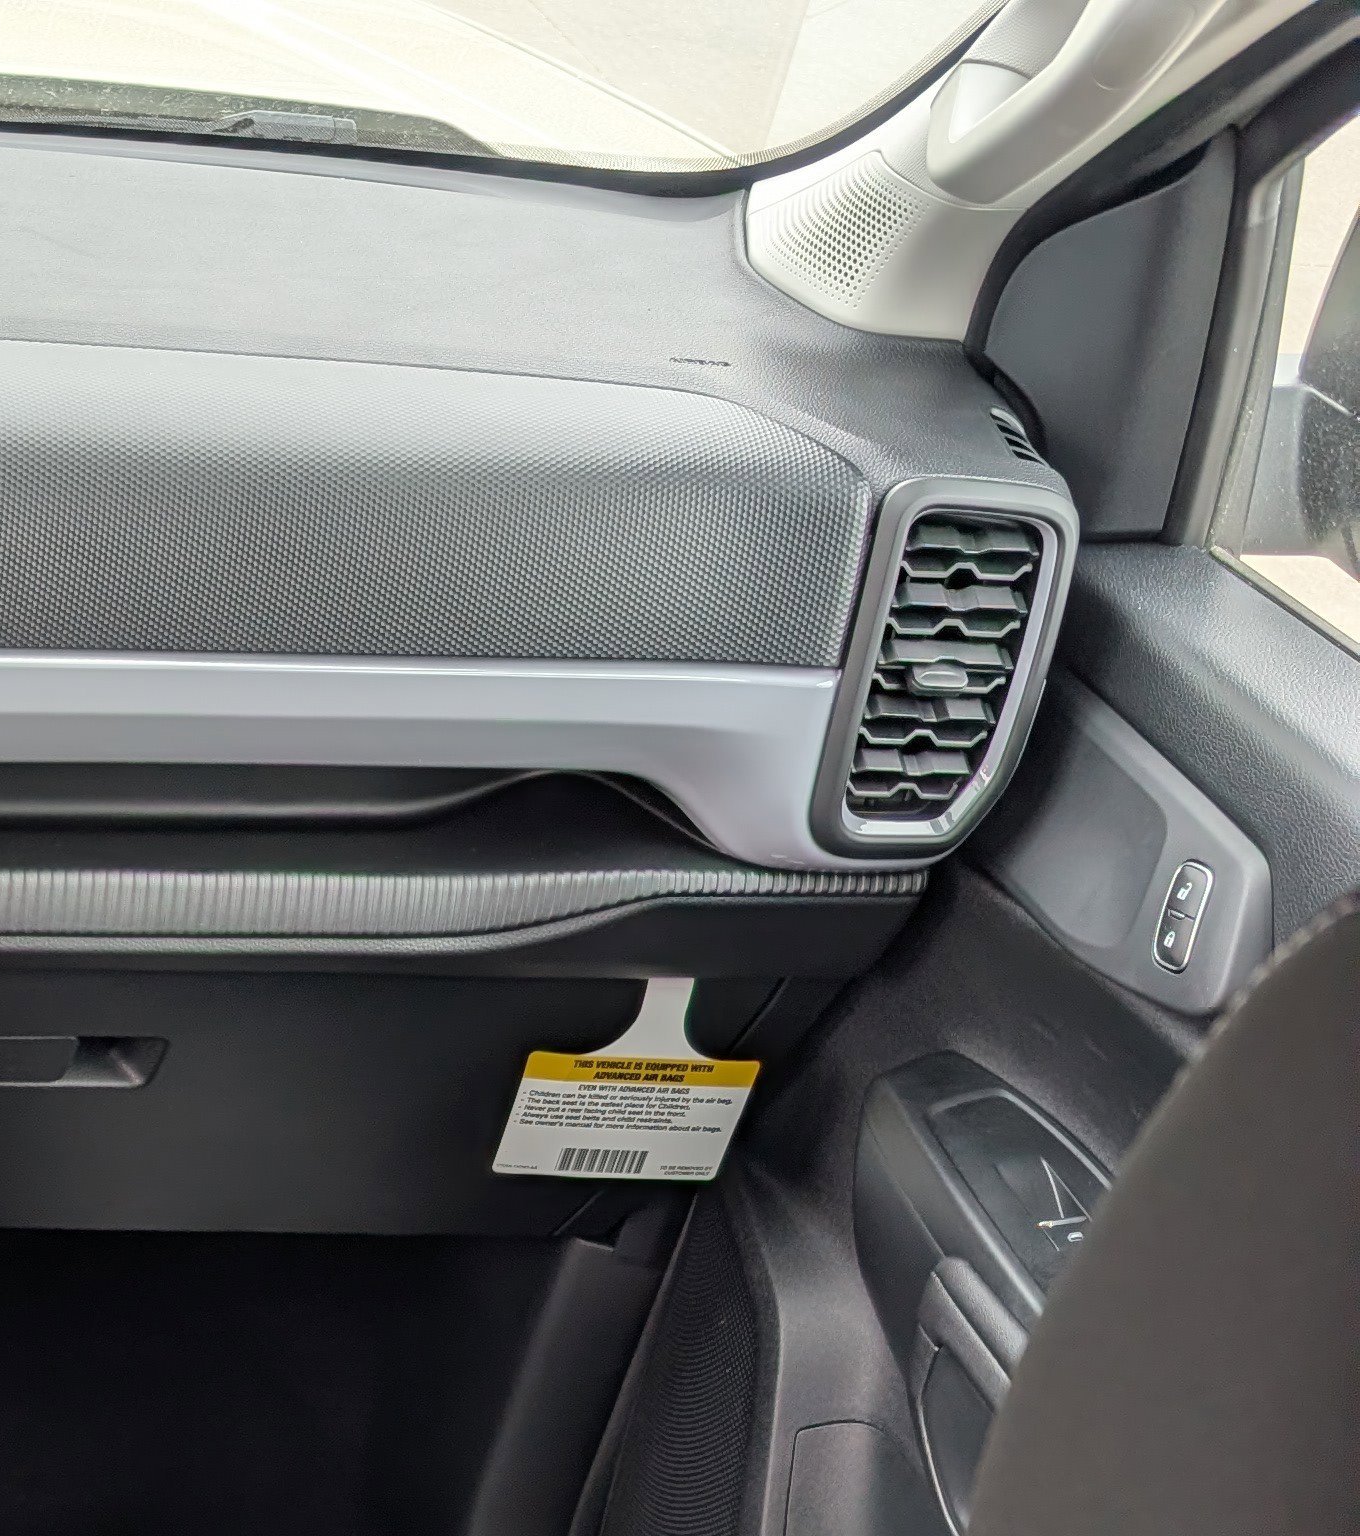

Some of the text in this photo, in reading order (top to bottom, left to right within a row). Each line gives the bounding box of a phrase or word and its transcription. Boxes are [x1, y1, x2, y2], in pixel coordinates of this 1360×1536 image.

[573, 1059, 715, 1073] THIS VEHICLE IS EQUIPPED WITH
[593, 1071, 685, 1083] ADVANCED AIR BAGS
